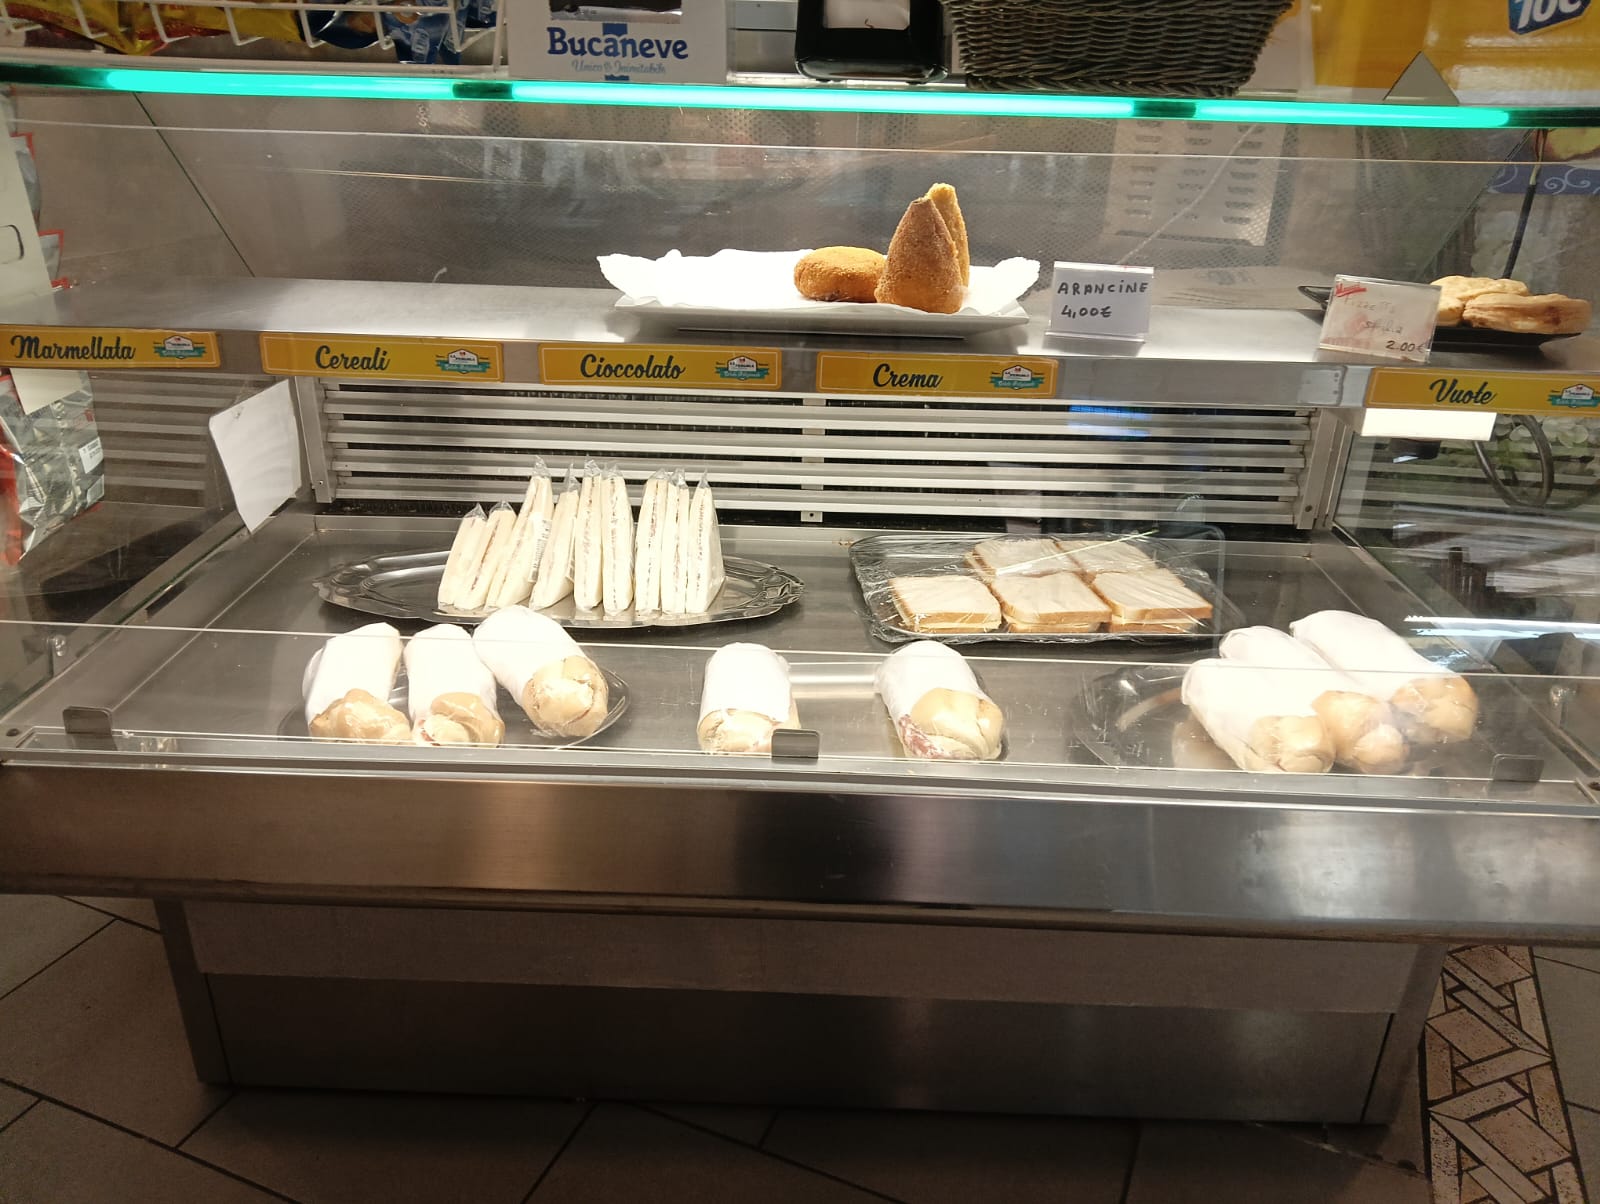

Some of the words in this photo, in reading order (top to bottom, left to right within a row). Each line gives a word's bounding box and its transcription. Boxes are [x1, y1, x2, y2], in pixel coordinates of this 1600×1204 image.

[547, 26, 689, 60] Bucaneve
[1061, 304, 1113, 320] 4,00€
[10, 335, 136, 360] Marmellata
[315, 345, 391, 371] Cereali
[580, 353, 686, 380] Cioccolato
[872, 363, 944, 389] Crema
[1429, 378, 1498, 405] Vuote
